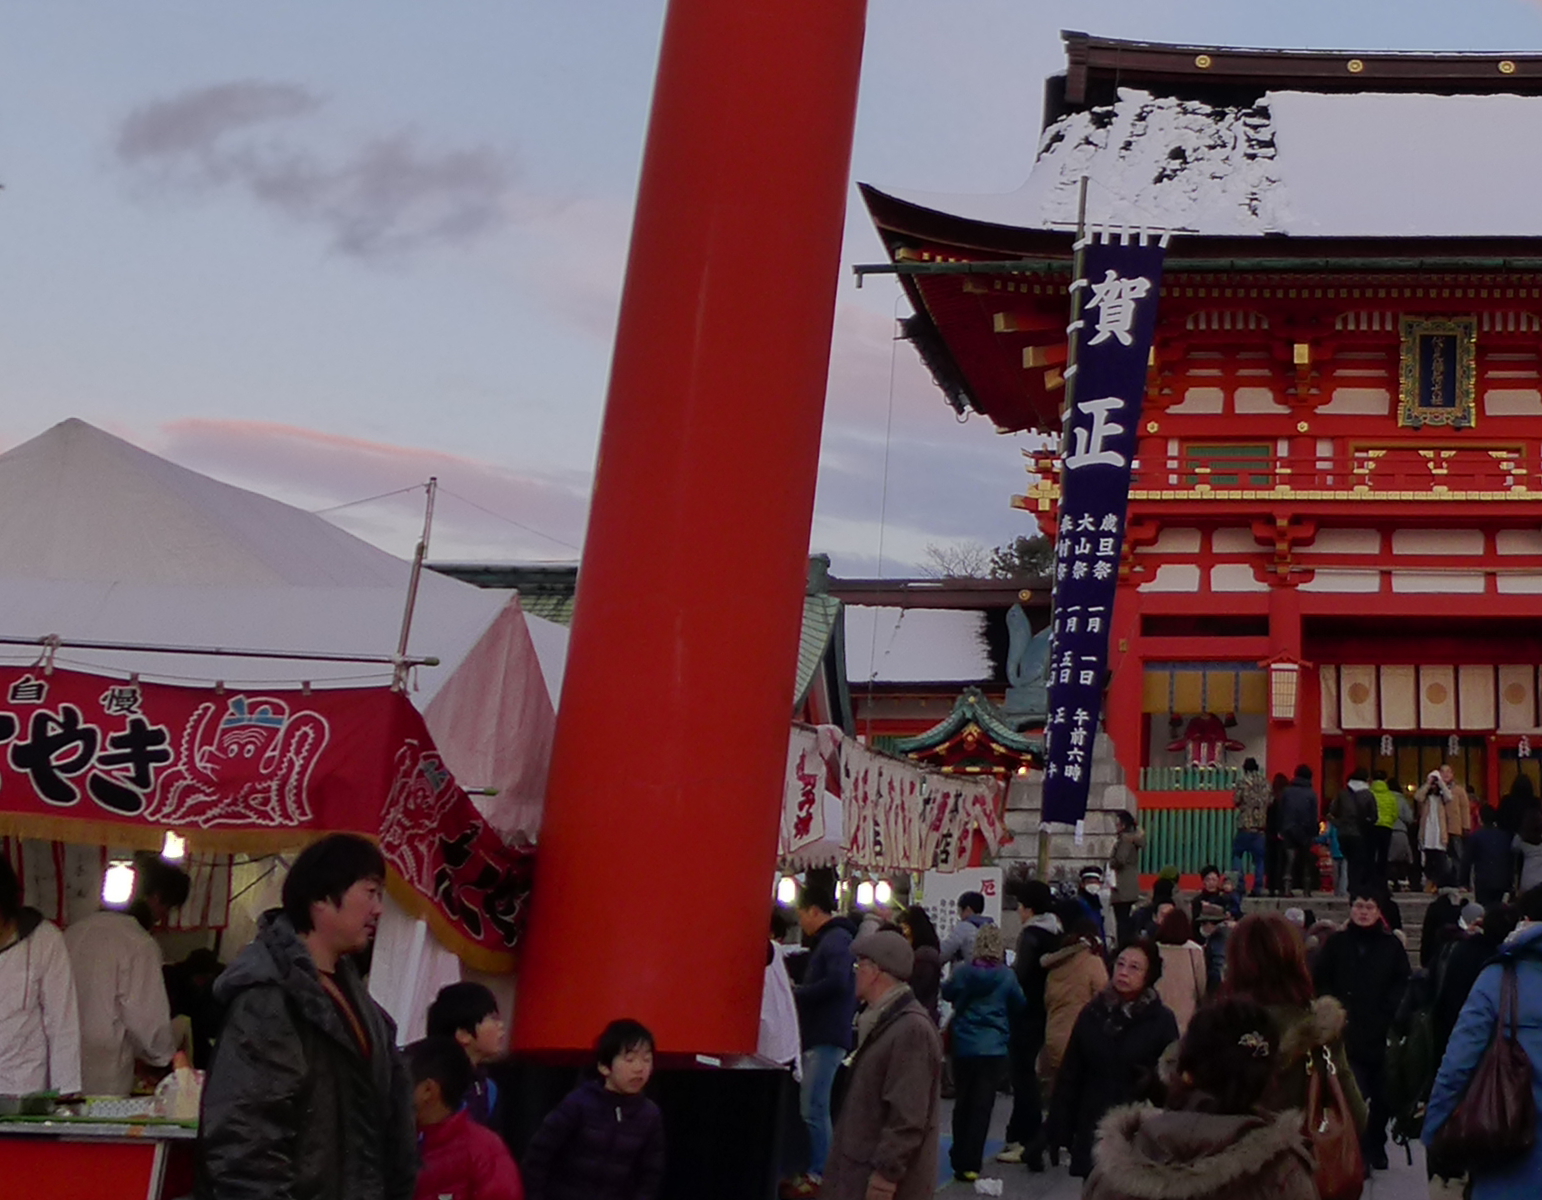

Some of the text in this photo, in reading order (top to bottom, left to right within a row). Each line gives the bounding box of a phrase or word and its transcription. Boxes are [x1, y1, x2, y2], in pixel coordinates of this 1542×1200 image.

[1064, 269, 1151, 470] 賀正
[1072, 513, 1096, 580] 大山祭
[1092, 512, 1119, 580] 歳旦祭
[0, 702, 174, 816] やき
